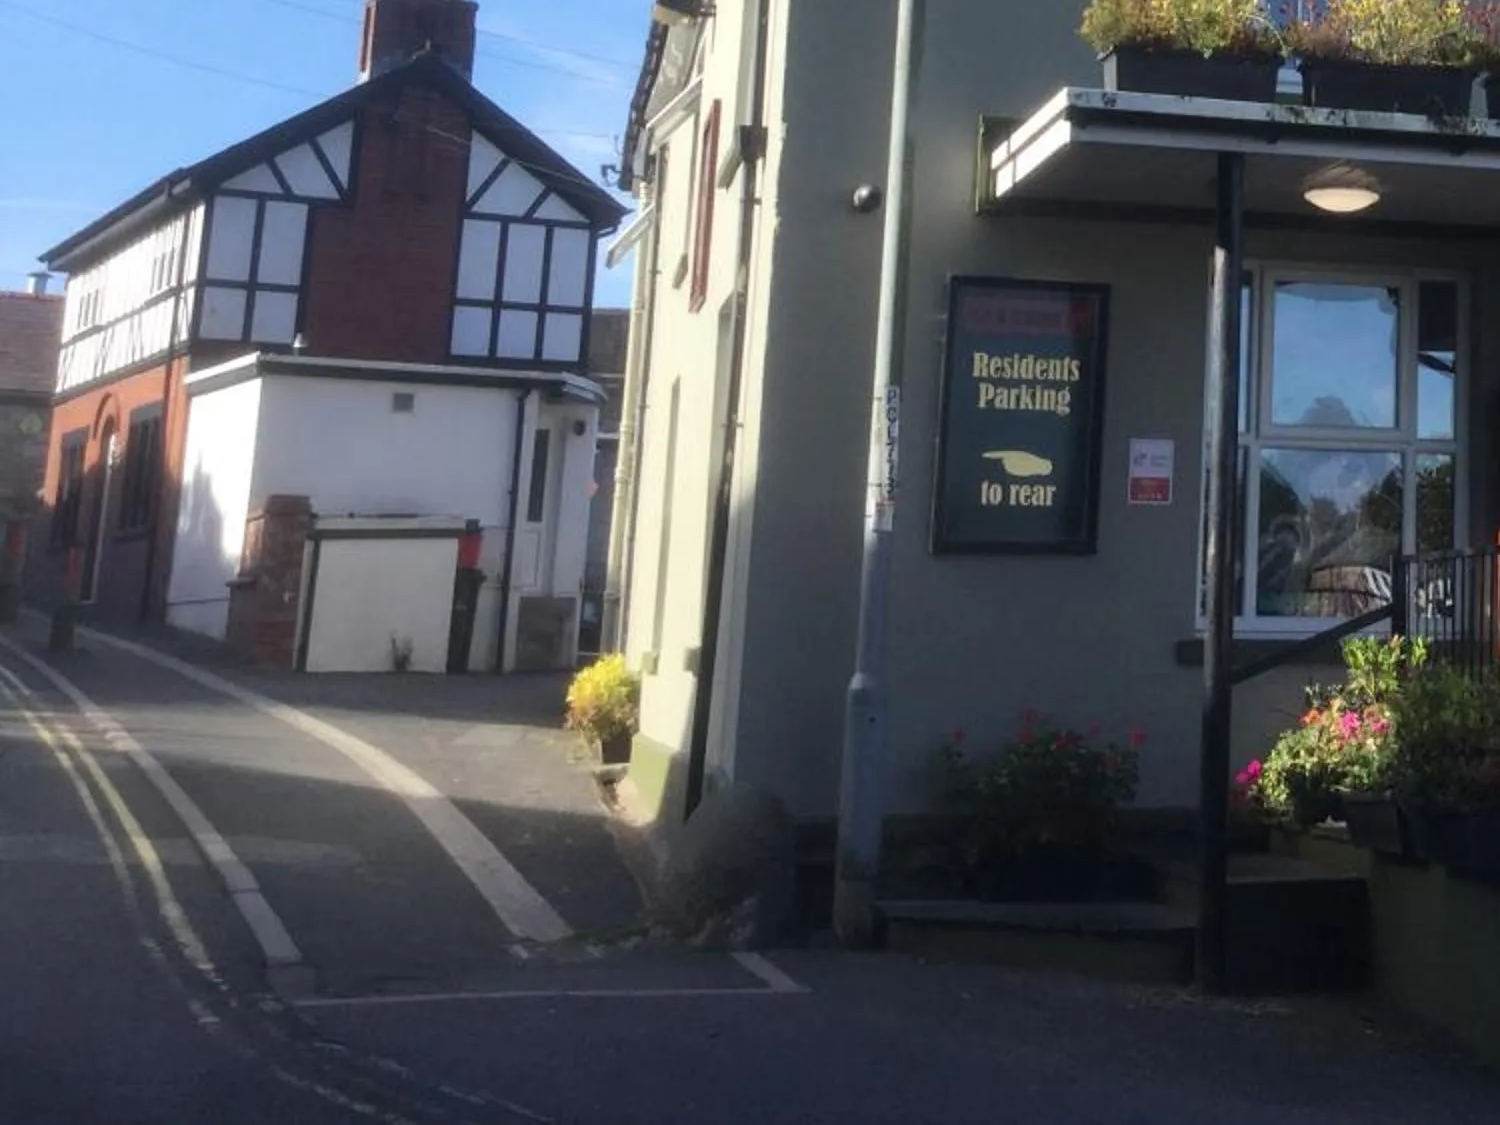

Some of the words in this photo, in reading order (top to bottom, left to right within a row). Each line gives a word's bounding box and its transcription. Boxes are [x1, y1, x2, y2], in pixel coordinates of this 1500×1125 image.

[973, 351, 1080, 382] Residents
[978, 382, 1071, 416] Parking
[981, 479, 1003, 505] to
[1009, 482, 1056, 506] rear
